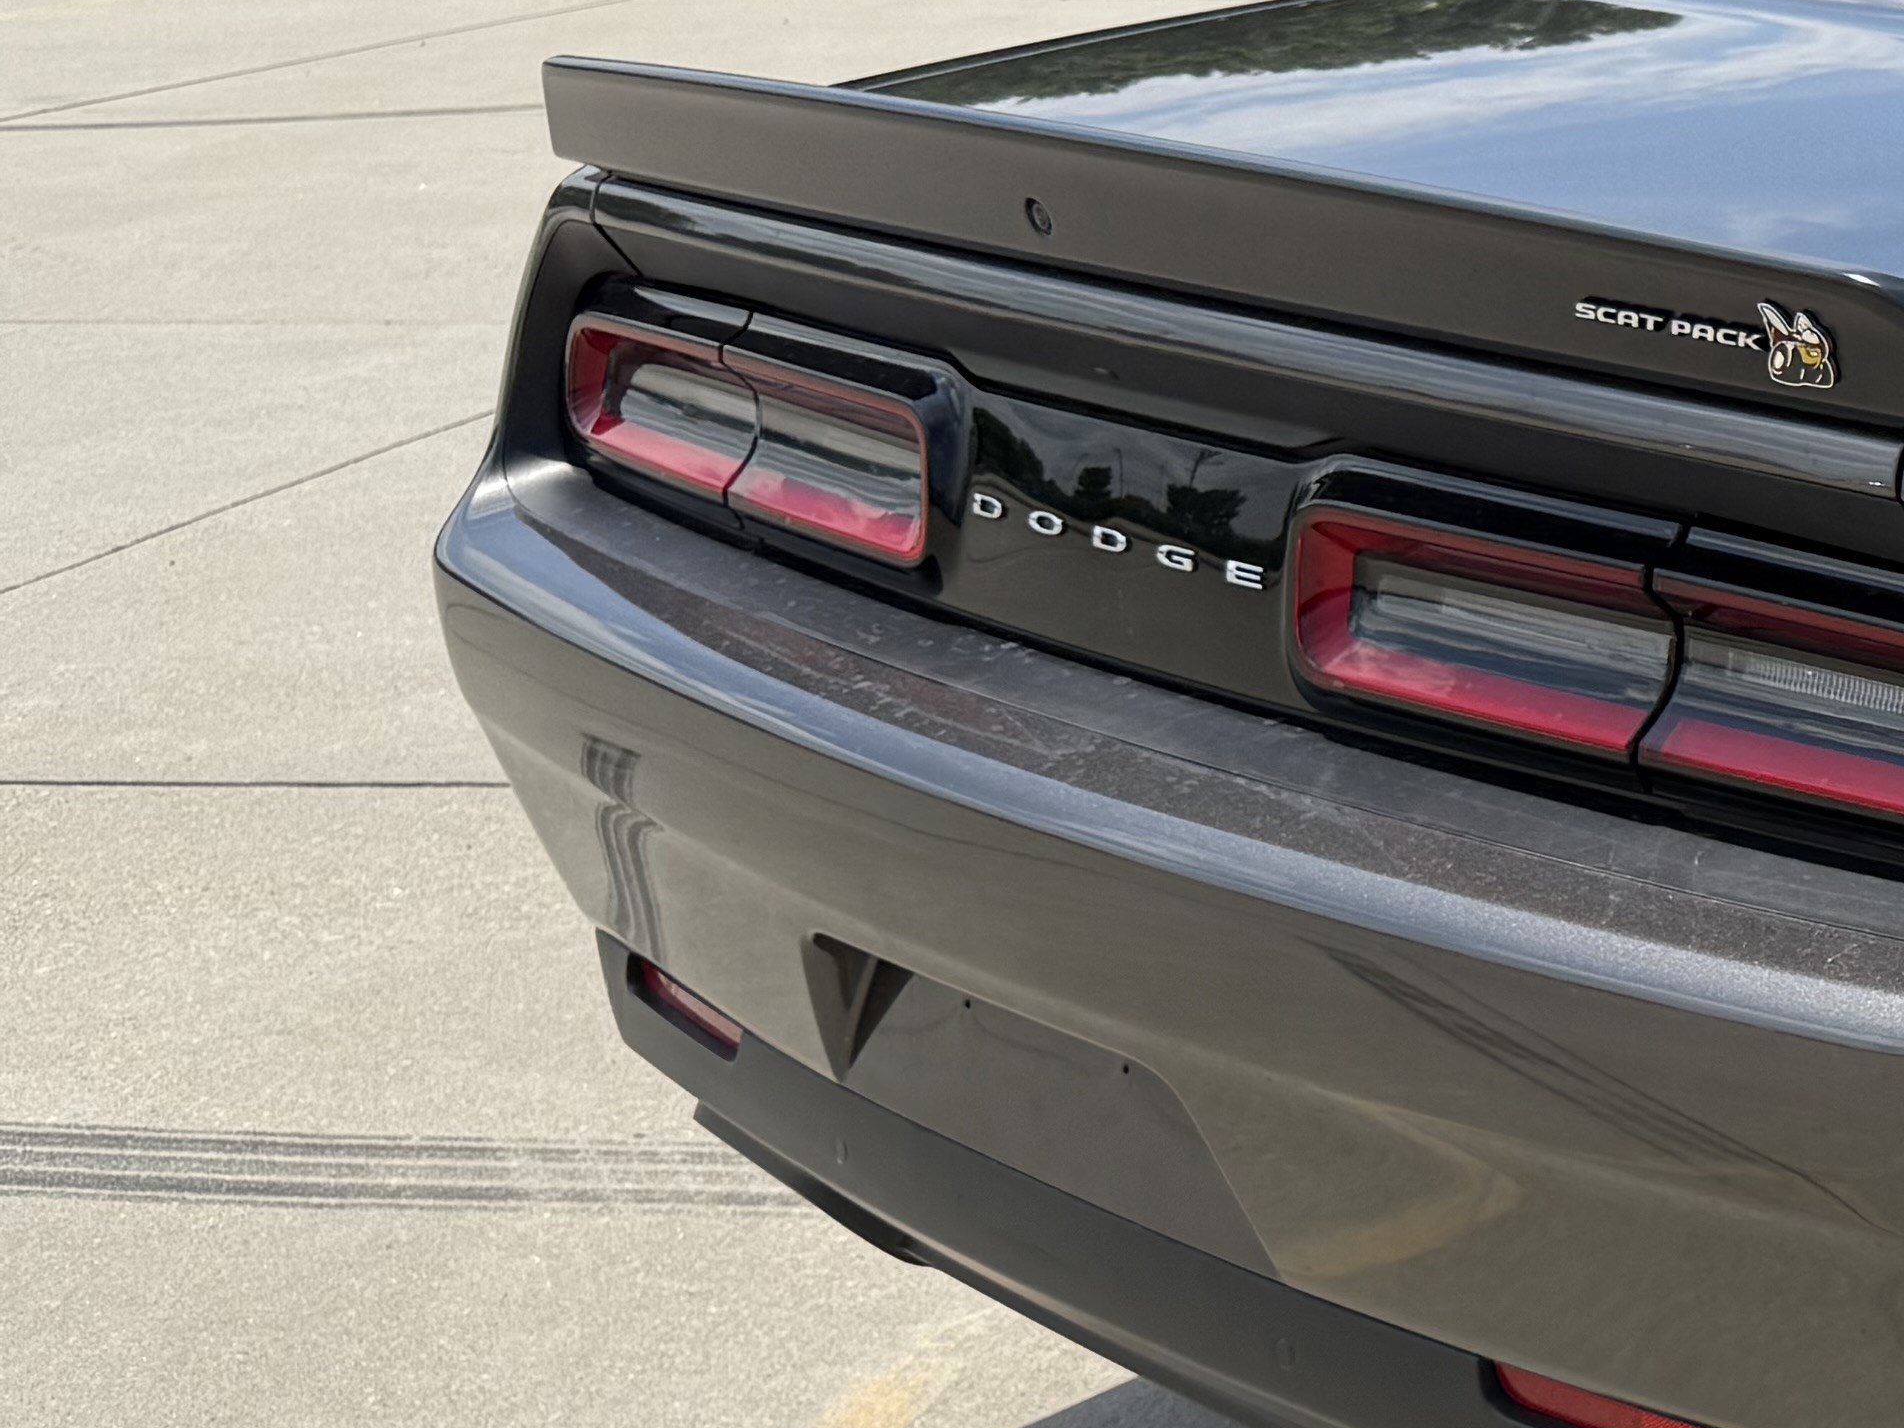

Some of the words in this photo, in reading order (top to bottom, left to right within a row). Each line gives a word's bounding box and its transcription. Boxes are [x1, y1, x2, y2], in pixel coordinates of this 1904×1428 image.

[1574, 301, 1664, 332] SCAT
[1671, 319, 1764, 350] PACK
[972, 492, 1264, 590] DODGE
